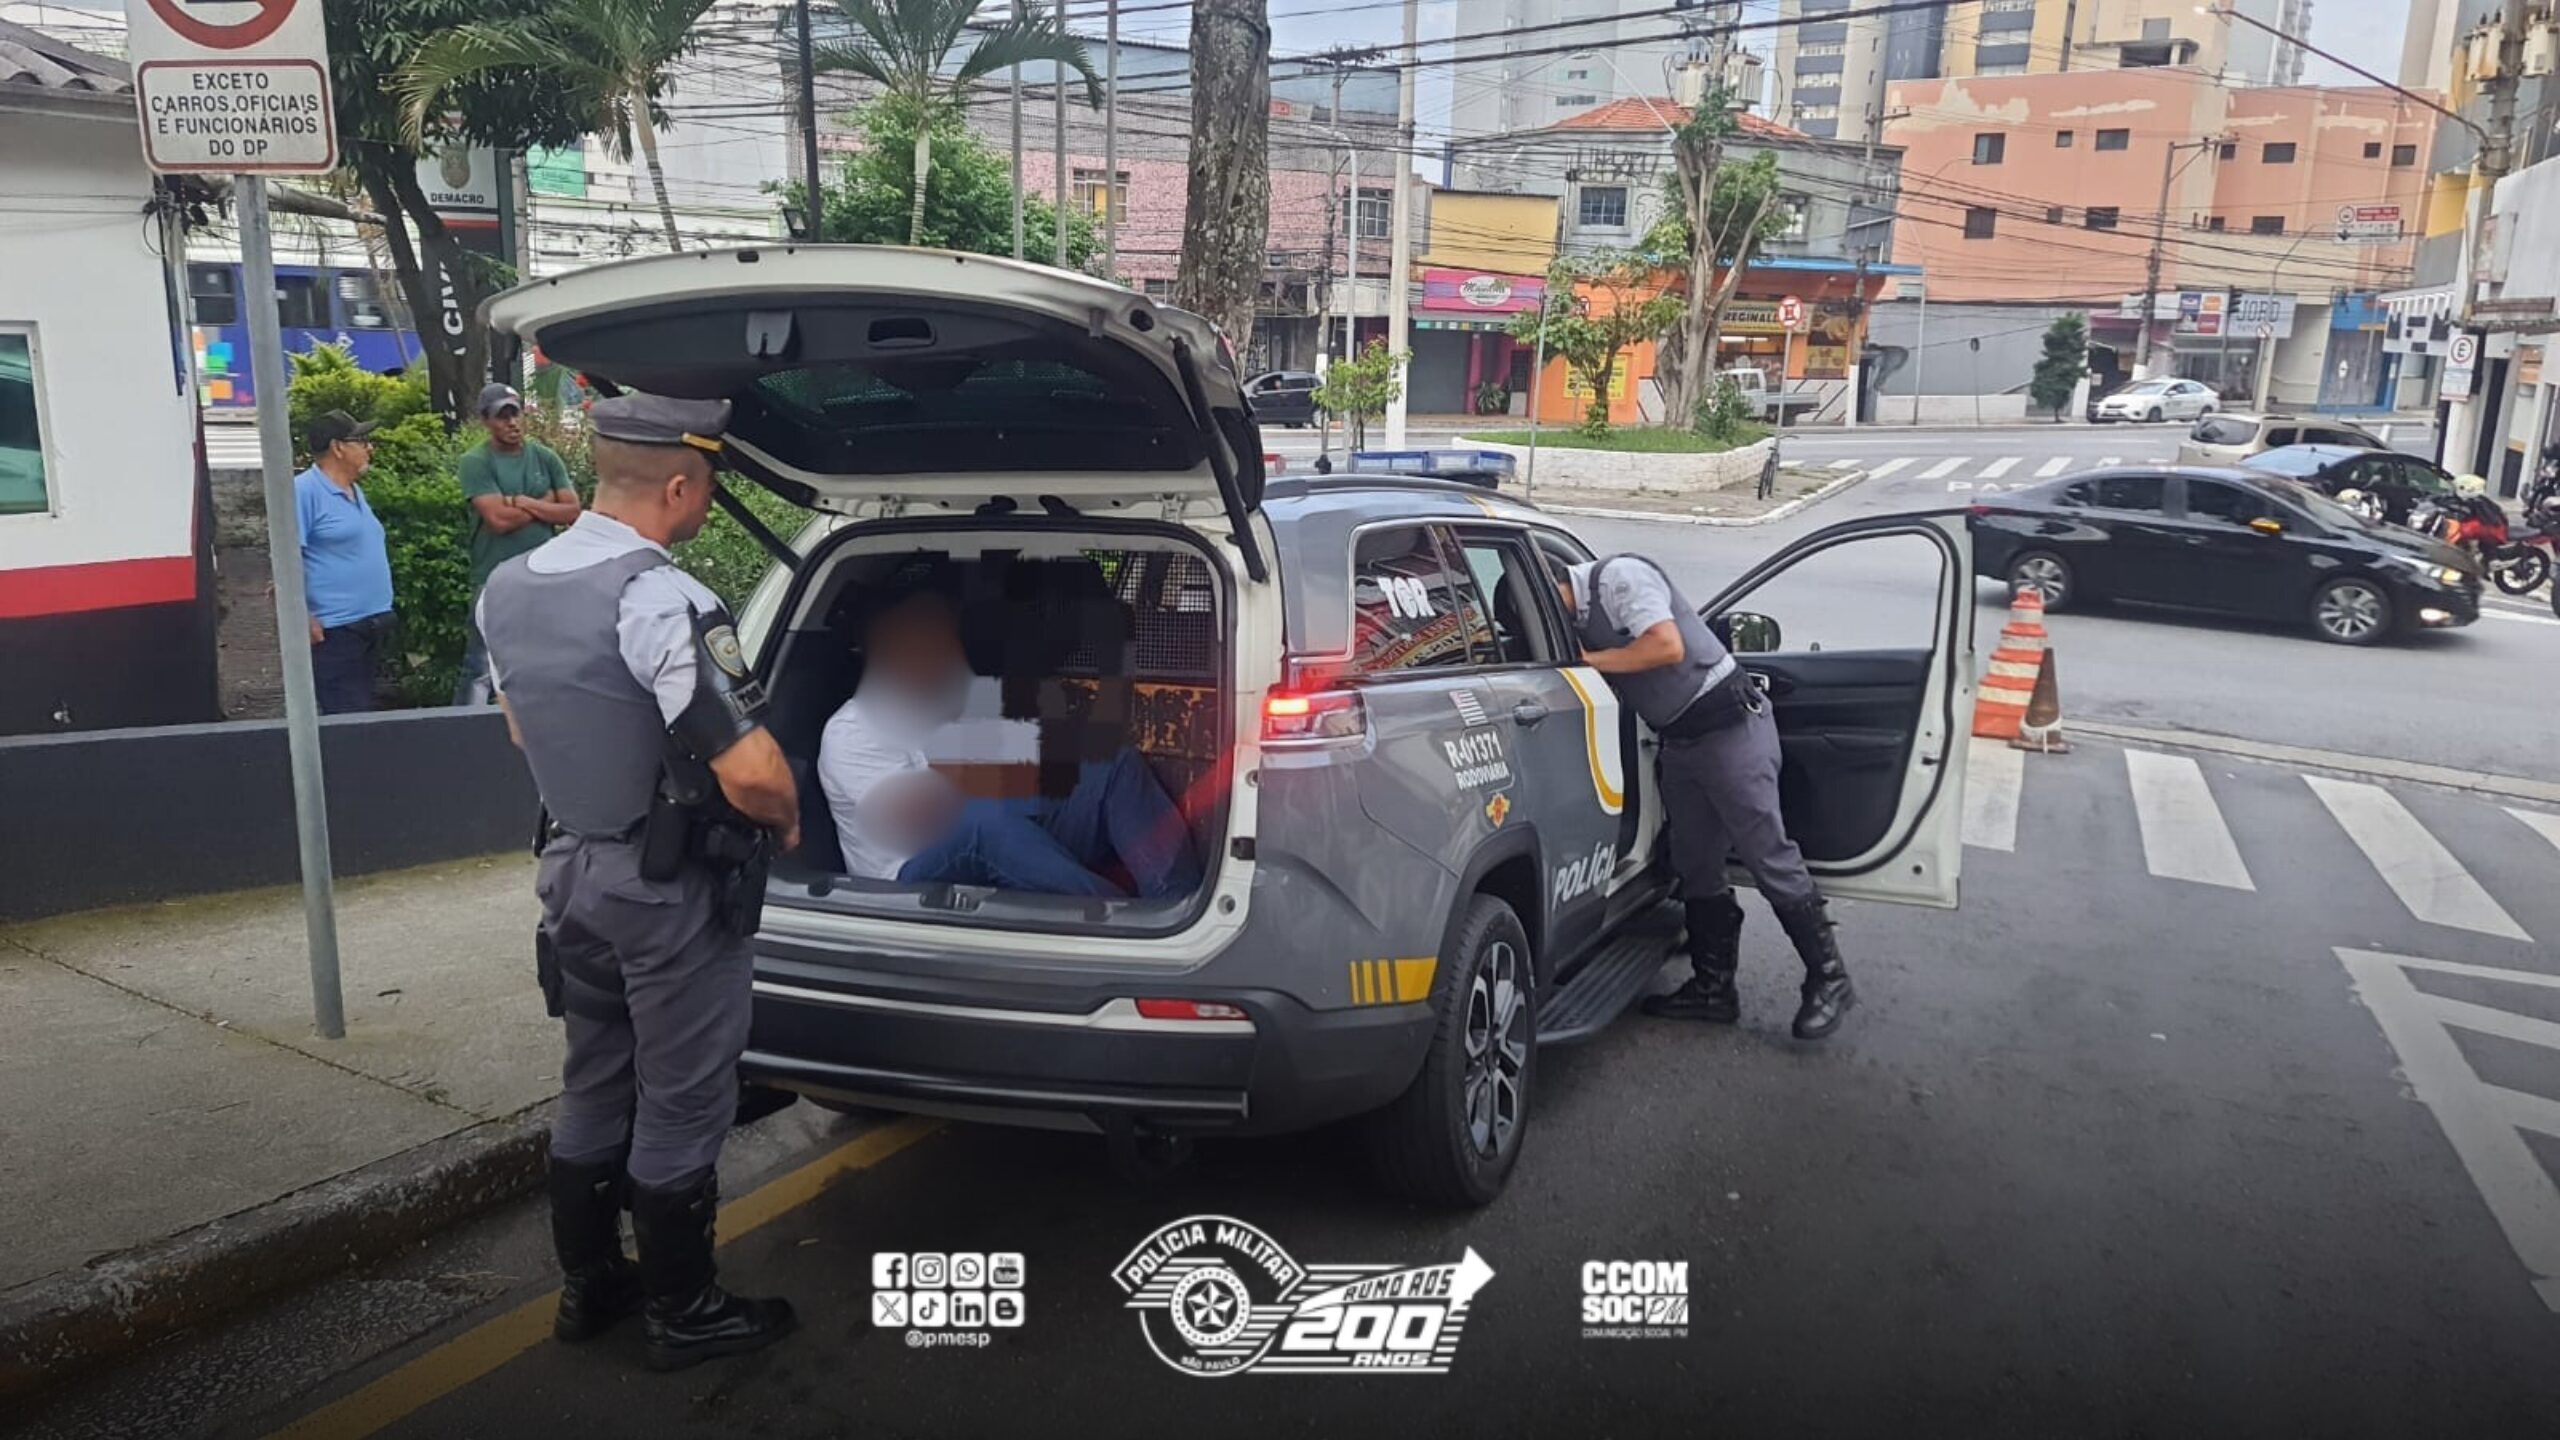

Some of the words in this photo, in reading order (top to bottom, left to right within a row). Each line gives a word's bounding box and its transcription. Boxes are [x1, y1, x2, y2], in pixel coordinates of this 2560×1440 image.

[192, 72, 269, 90] EXCETO
[151, 95, 229, 113] CARROS
[236, 94, 319, 112] OFICIAIS
[158, 118, 169, 134] E
[175, 113, 318, 134] FUNCIONÁRIOS
[208, 139, 234, 156] DO
[243, 139, 268, 155] DP
[430, 192, 484, 204] DEMACRO
[2457, 342, 2467, 358] E
[1377, 576, 1437, 619] TOR
[1443, 730, 1504, 768] R-01371
